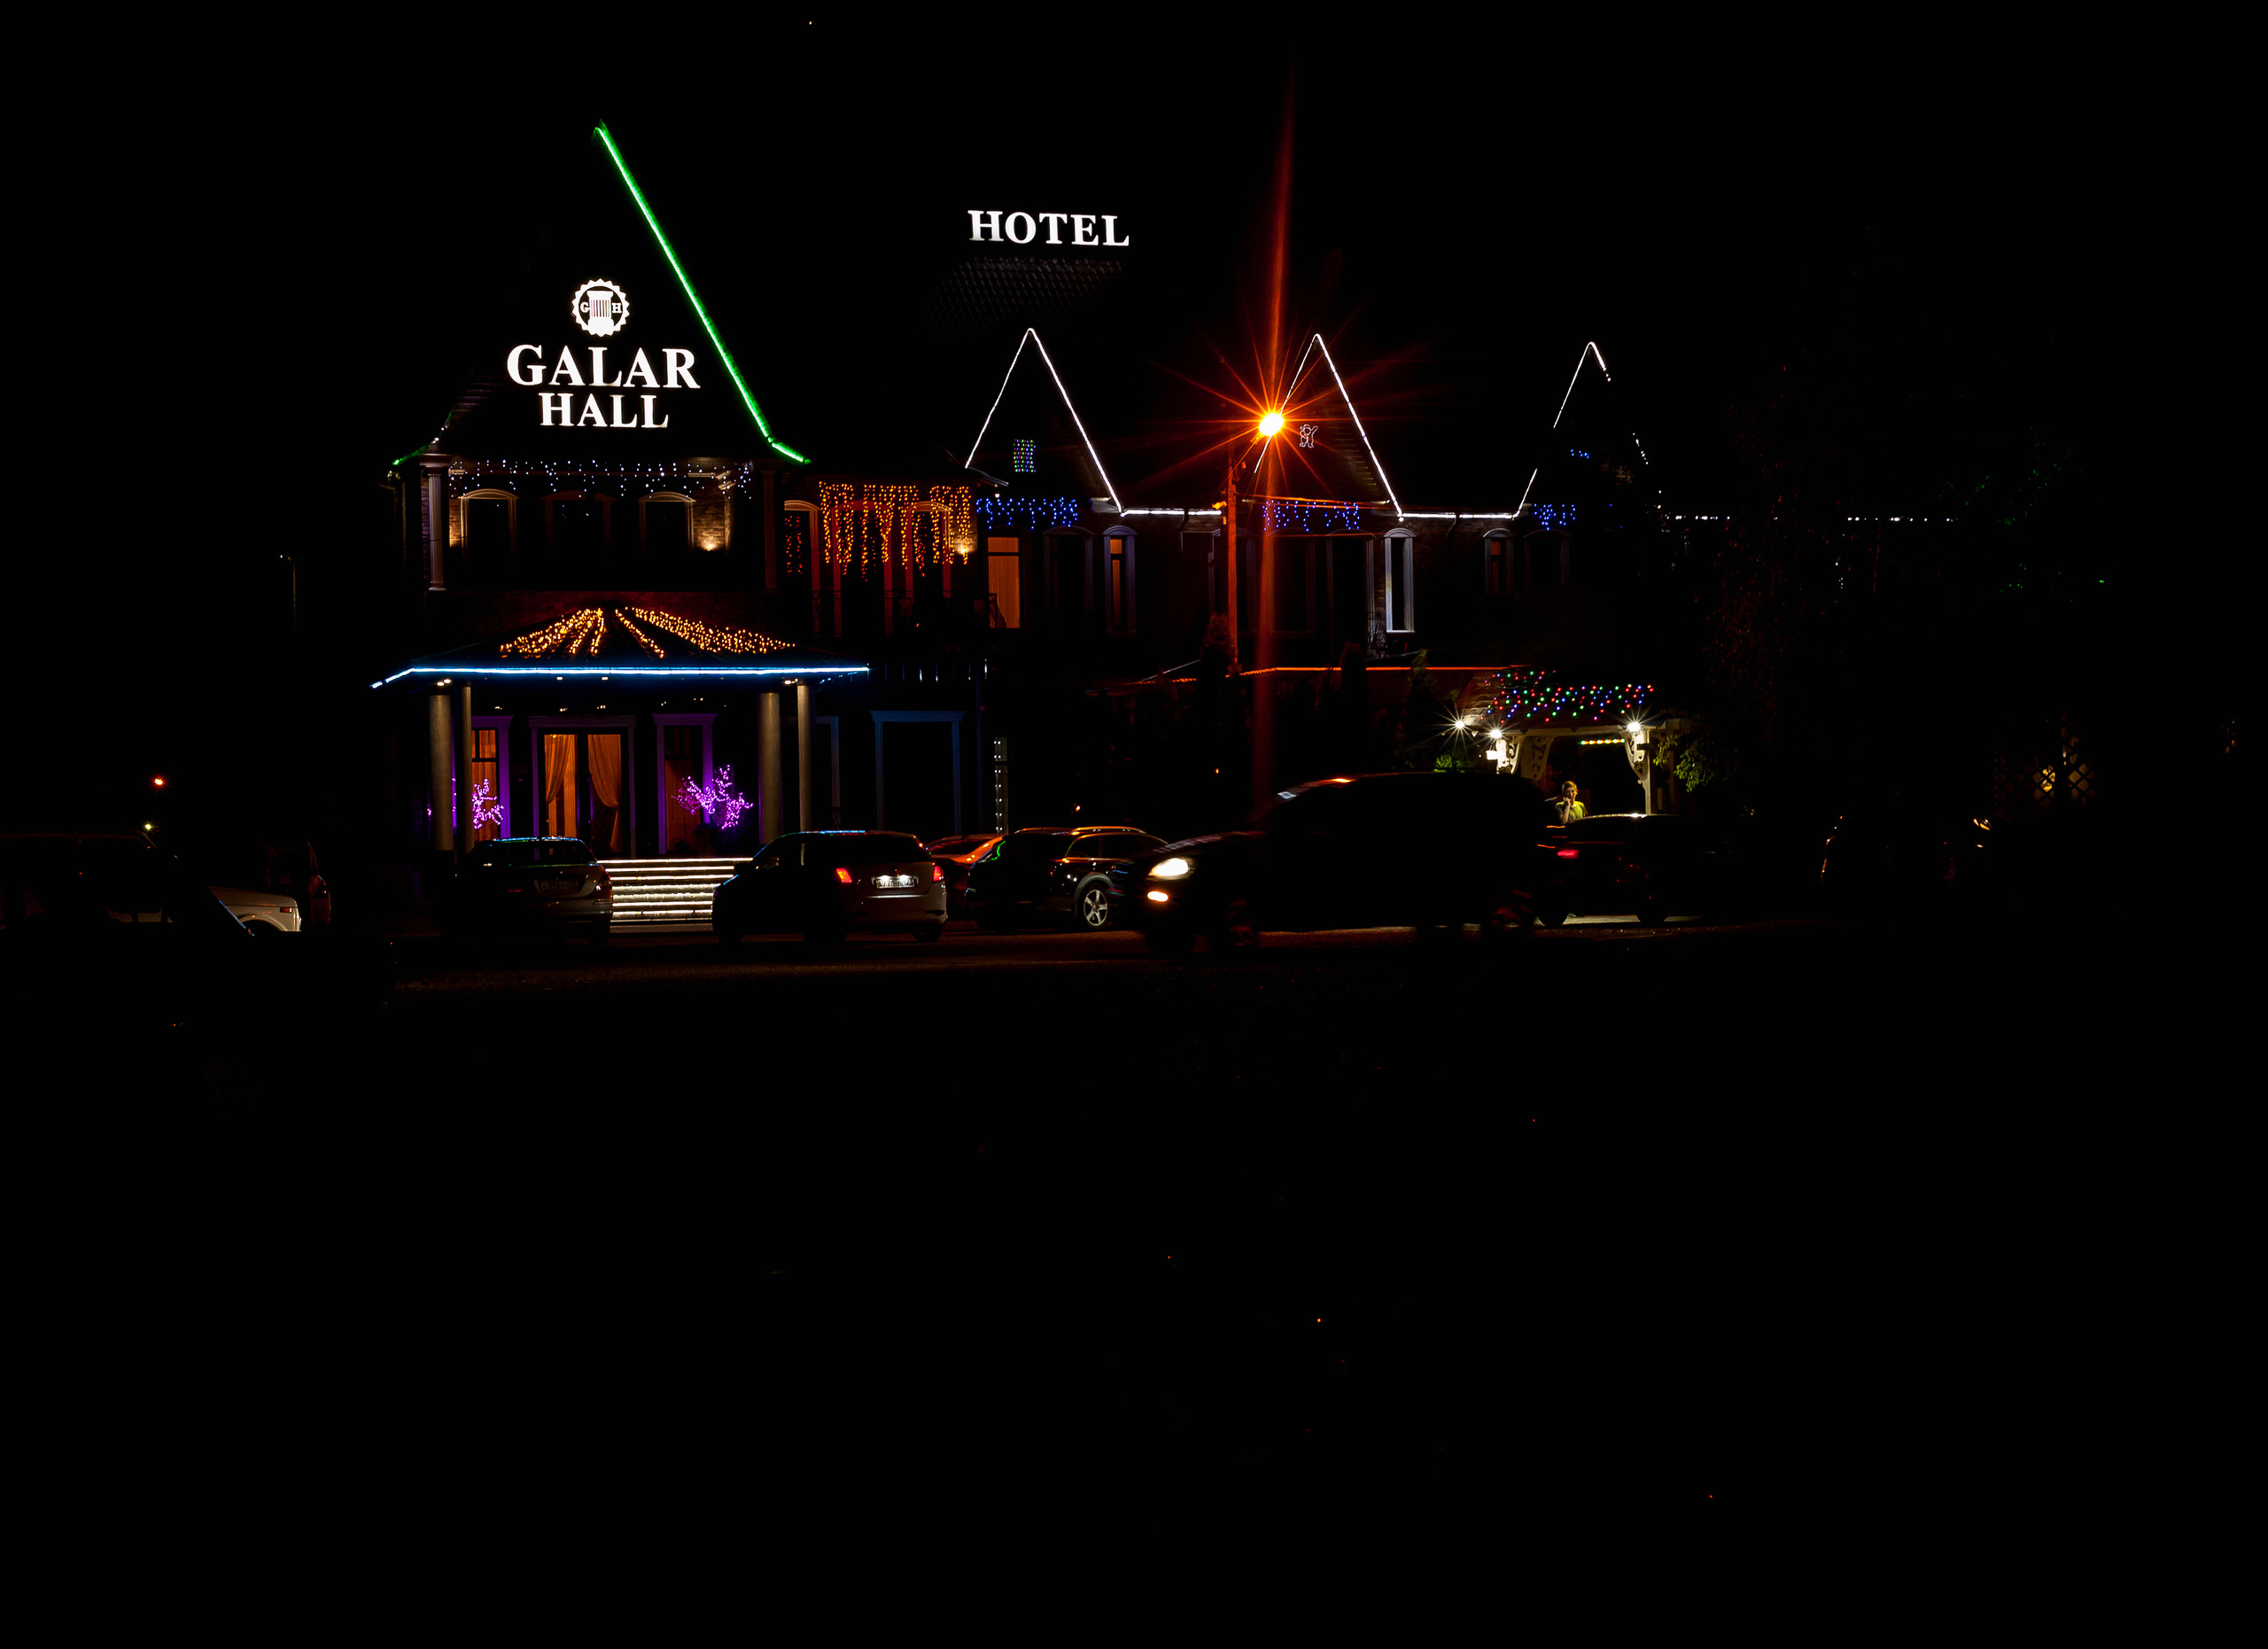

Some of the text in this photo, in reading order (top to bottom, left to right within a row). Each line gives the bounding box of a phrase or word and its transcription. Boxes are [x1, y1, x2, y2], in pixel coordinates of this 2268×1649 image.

[967, 210, 1130, 246] HOTEL
[580, 302, 622, 313] G H
[507, 344, 701, 388] GALAR
[538, 393, 669, 428] HALL
